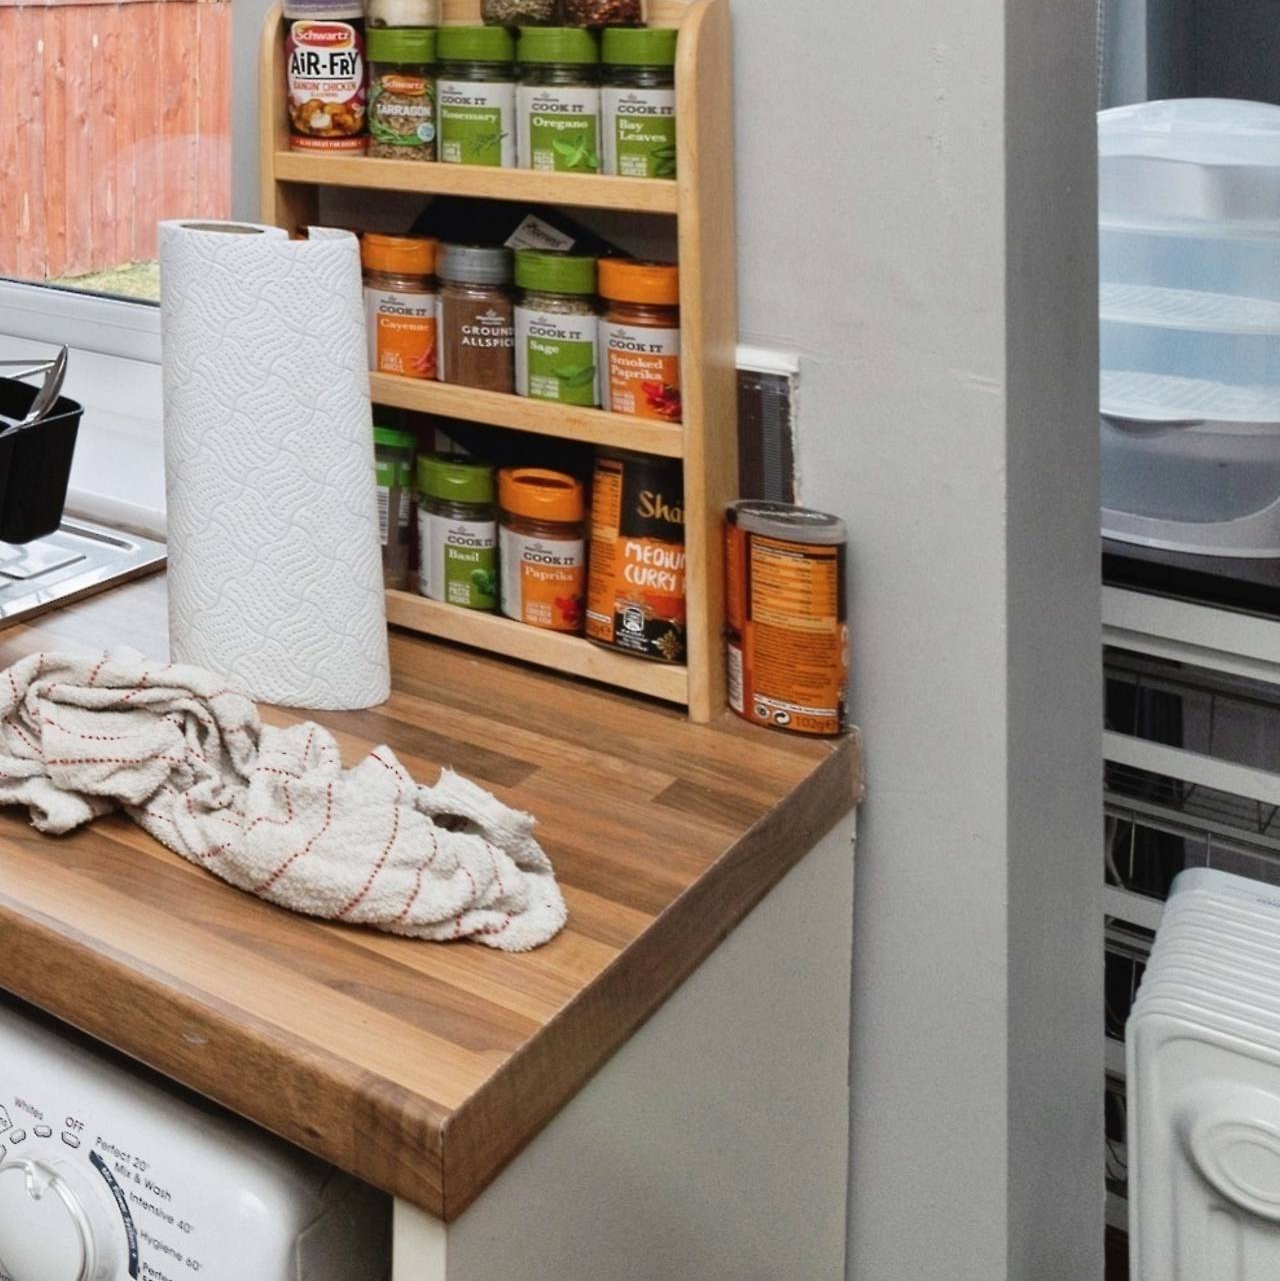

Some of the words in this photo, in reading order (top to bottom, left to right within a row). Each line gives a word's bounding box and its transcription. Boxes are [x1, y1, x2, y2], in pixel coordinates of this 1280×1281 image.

[295, 28, 349, 41] Schwartz
[382, 79, 424, 89] Schwartz
[441, 96, 471, 105] COOK
[474, 97, 487, 105] IT
[531, 103, 569, 112] COOK
[572, 104, 585, 112] IT
[376, 104, 432, 117] TARRAGON
[443, 109, 498, 123] Rosemary
[618, 105, 657, 114] COOK
[660, 106, 674, 114] IT
[533, 116, 589, 130] Oregano
[619, 118, 645, 132] Bay
[619, 130, 668, 142] Leaves
[379, 305, 413, 316] COOK
[416, 308, 427, 316] IT
[380, 318, 429, 332] Cayenne
[529, 326, 566, 339] COOK
[569, 331, 583, 340] IT
[529, 340, 559, 356] Sage
[608, 339, 646, 352] COOK
[649, 344, 663, 353] IT
[609, 352, 663, 369] Smoked
[610, 364, 663, 380] Paprika
[637, 490, 685, 524] Sha
[448, 535, 482, 547] COOK
[484, 539, 493, 547] IT
[448, 548, 480, 562] Basil
[523, 552, 562, 565] COOK
[564, 557, 576, 565] IT
[524, 565, 574, 582] Paprika
[623, 563, 676, 592] CURRY
[14, 1096, 44, 1121] Whites
[65, 1116, 86, 1133] OFF
[95, 1136, 131, 1162] Perfect
[113, 1162, 131, 1179] Mix
[144, 1178, 173, 1203] Wash
[128, 1191, 175, 1225] Intensive
[140, 1230, 183, 1262] Hygiene
